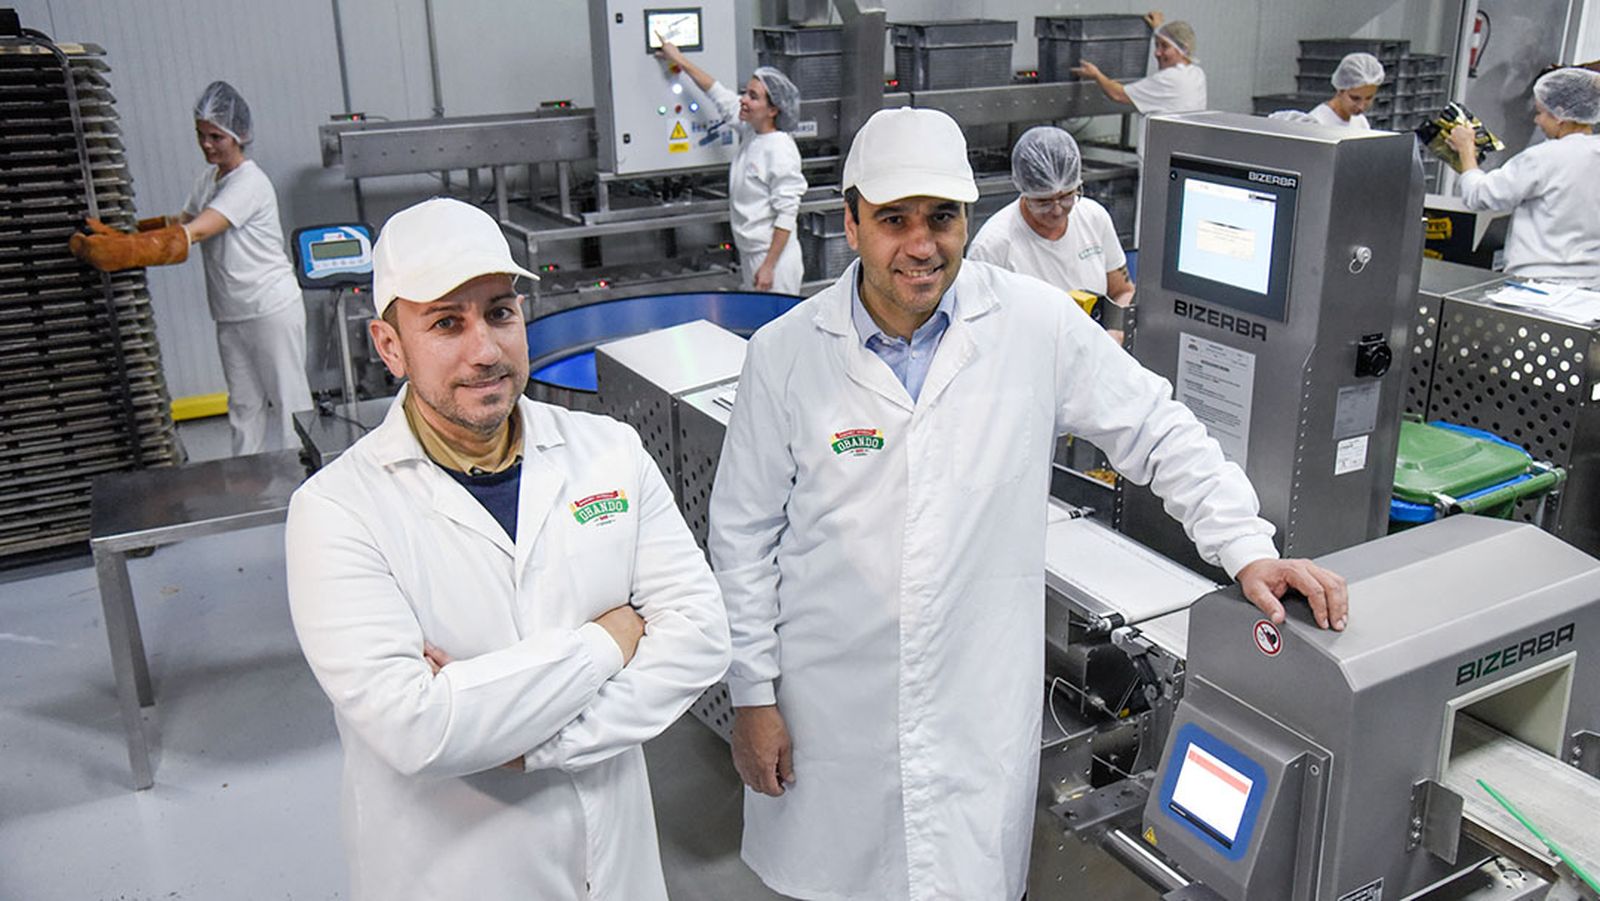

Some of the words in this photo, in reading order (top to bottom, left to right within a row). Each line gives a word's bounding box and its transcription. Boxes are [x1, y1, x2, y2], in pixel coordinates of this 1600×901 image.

[1247, 171, 1297, 188] BIZERBA
[1174, 299, 1267, 342] BIZERBA
[837, 436, 879, 451] OBANDO
[579, 499, 623, 521] OBANDO
[1455, 622, 1576, 687] BIZERBA
